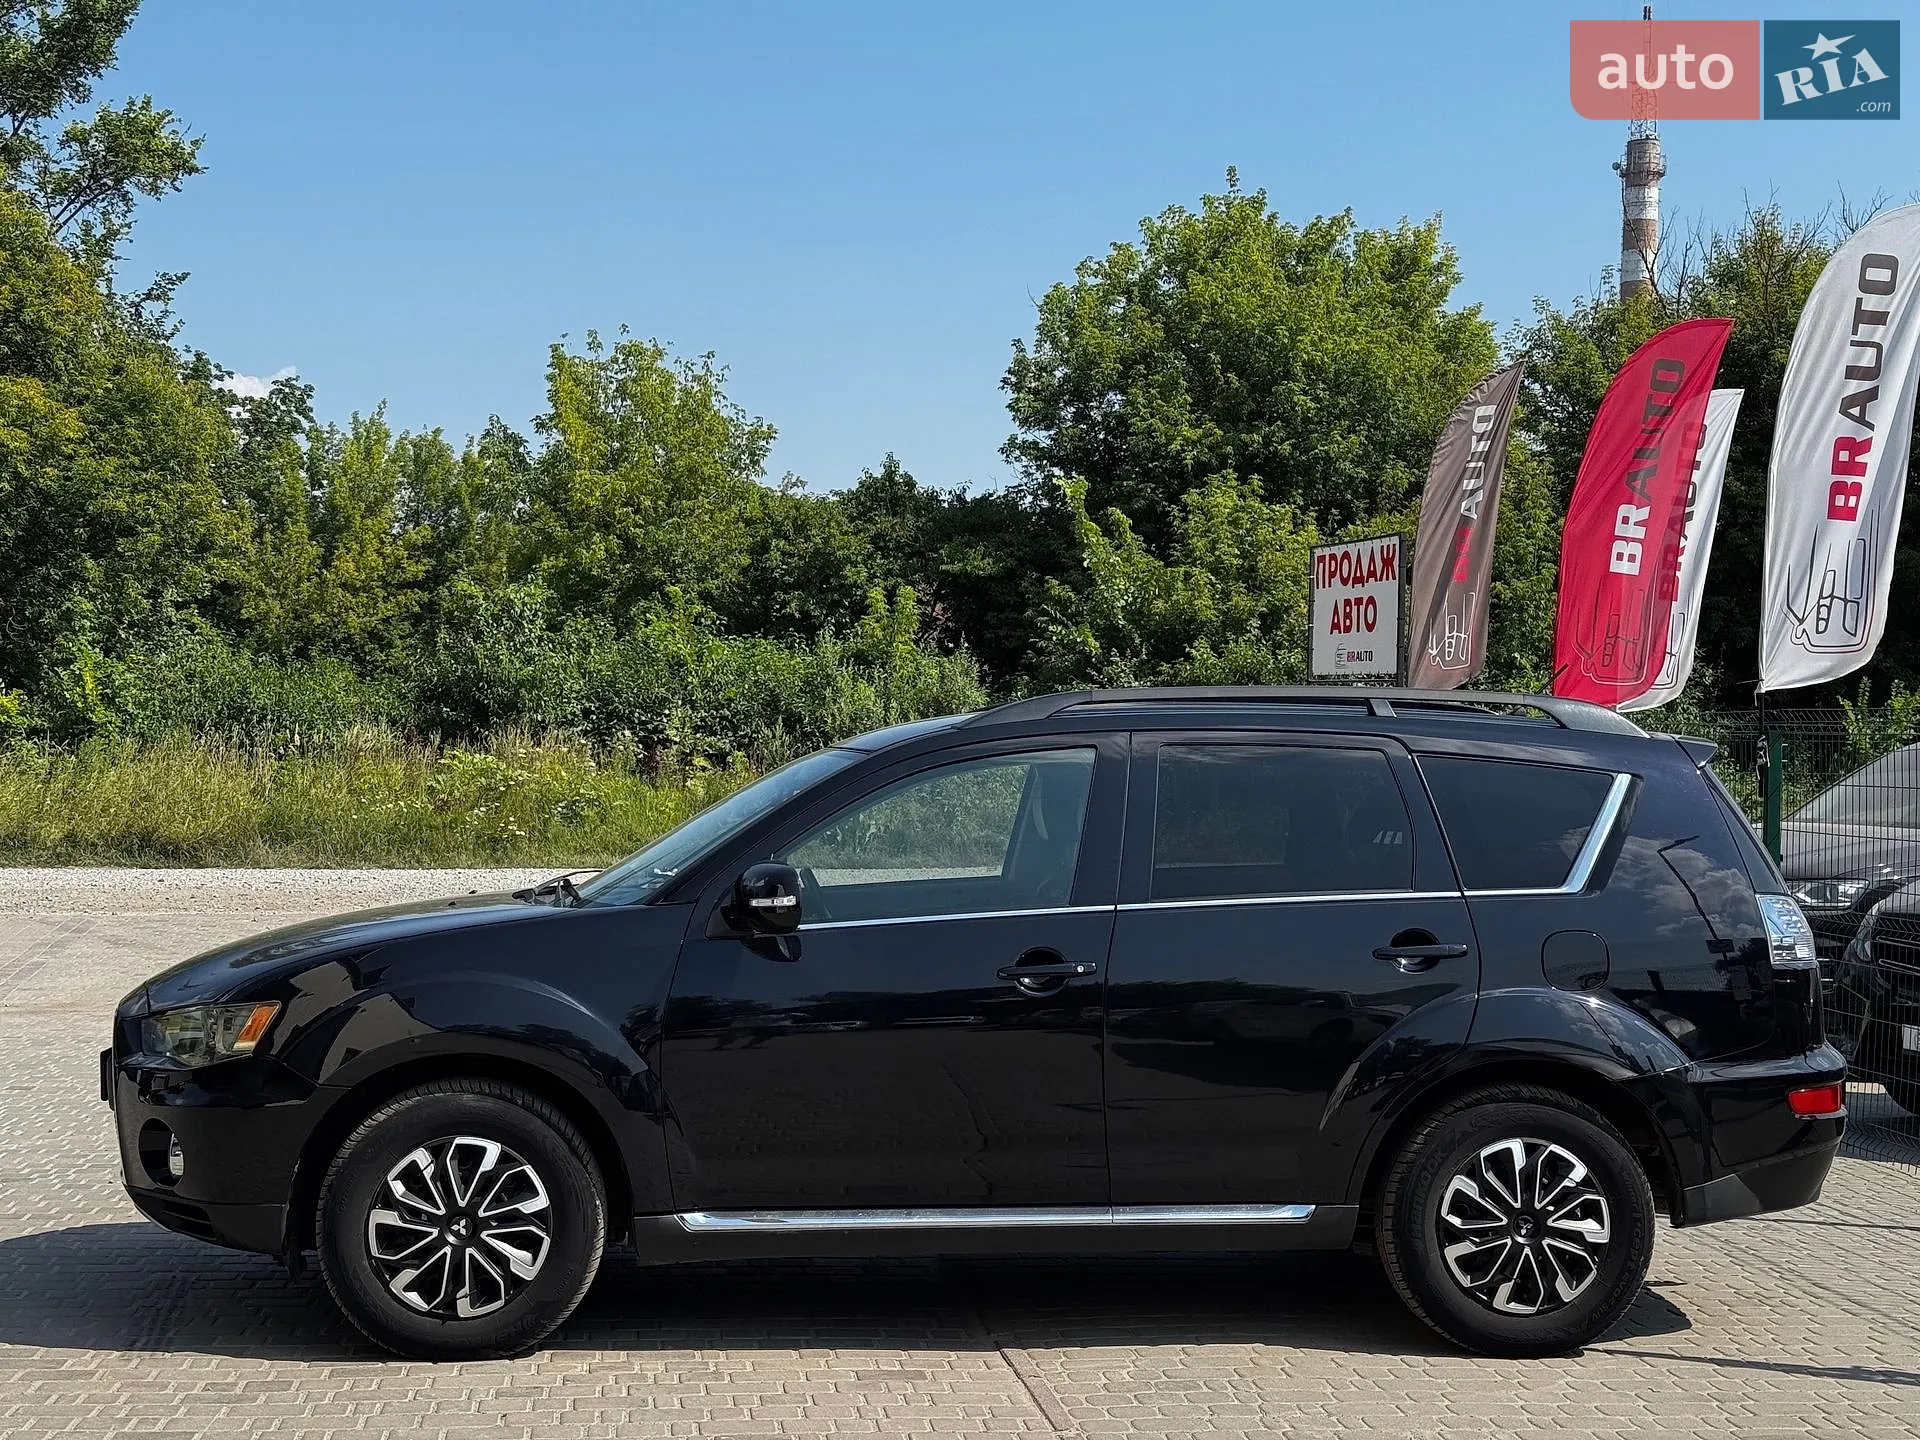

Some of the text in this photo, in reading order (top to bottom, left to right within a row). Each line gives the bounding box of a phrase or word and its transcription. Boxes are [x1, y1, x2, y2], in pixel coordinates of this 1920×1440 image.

[1826, 252, 1900, 522] BRAUTO
[1608, 358, 1685, 577] BRAUTO
[1315, 543, 1397, 590] ПРОДАЖ
[1329, 595, 1378, 636] АВТО
[1346, 650, 1374, 663] BRAUTO
